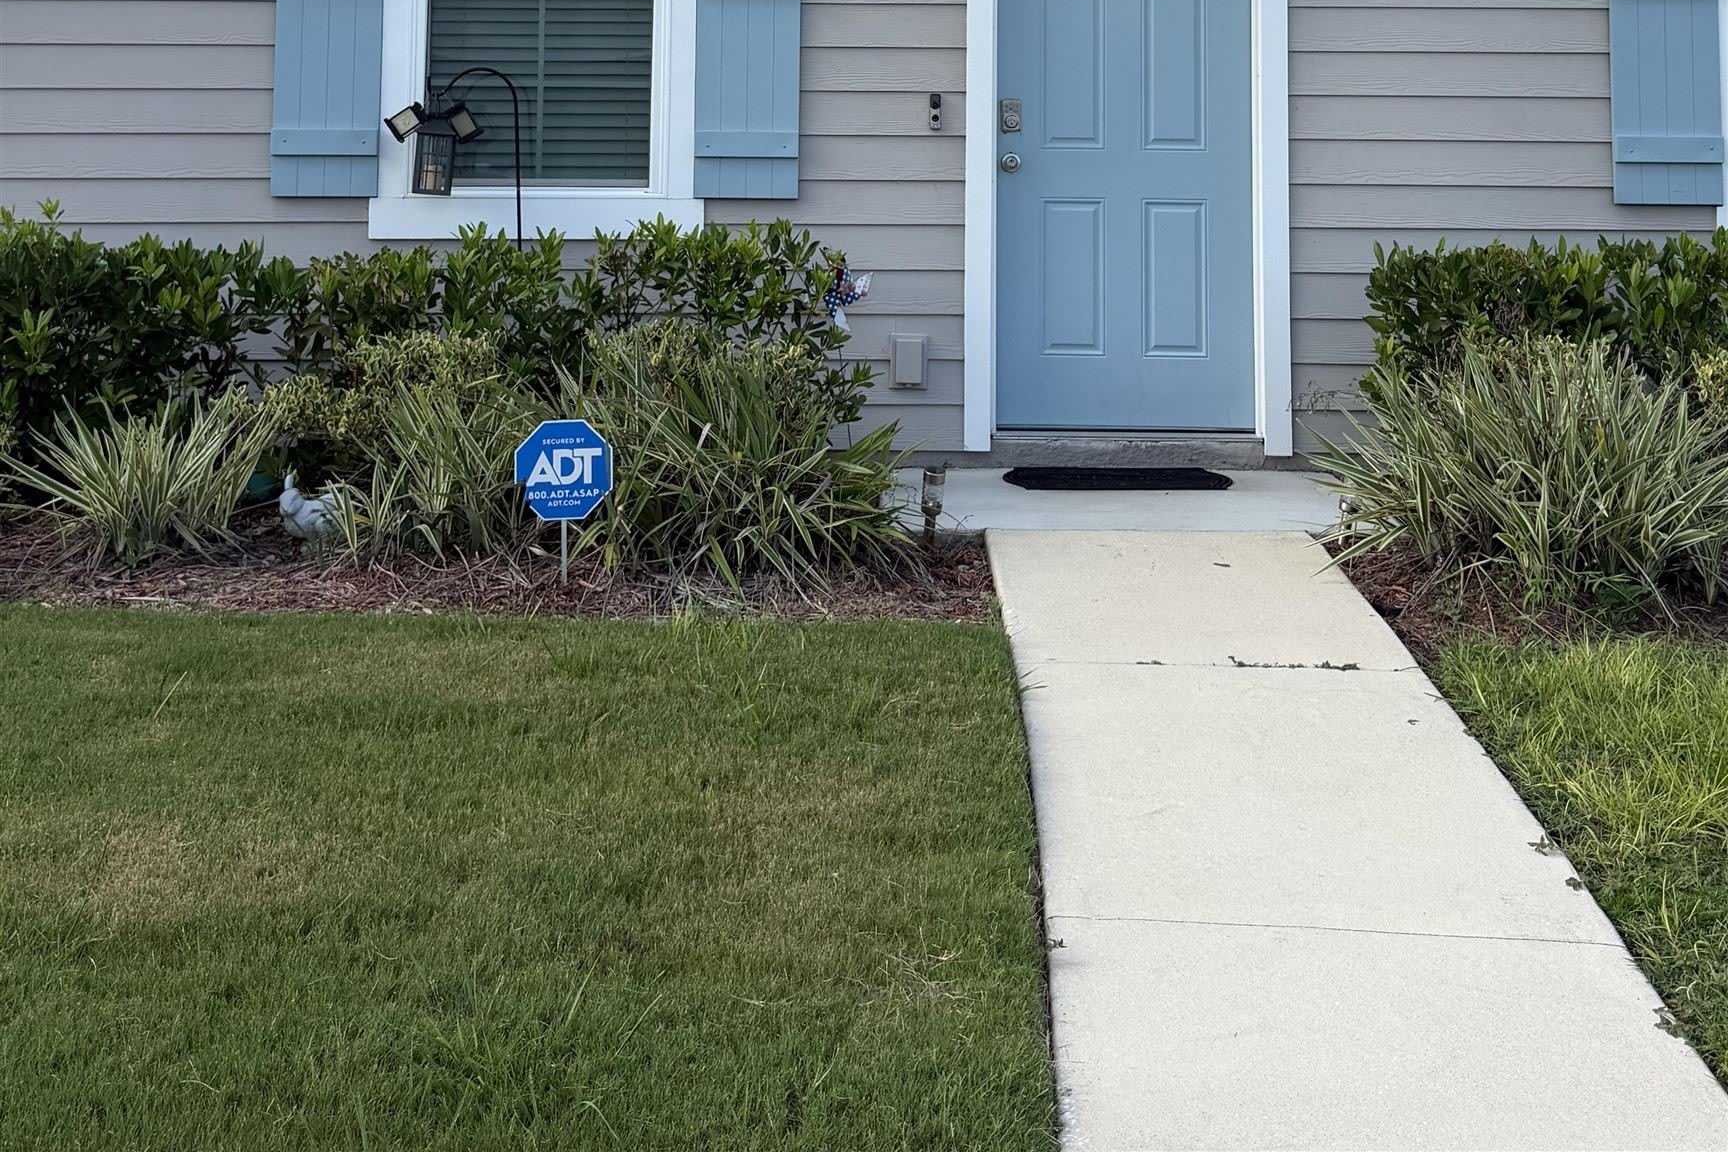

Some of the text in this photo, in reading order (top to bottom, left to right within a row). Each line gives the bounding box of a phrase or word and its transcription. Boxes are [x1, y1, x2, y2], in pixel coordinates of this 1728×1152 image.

[526, 448, 602, 486] ADT
[528, 488, 600, 500] 800.ADT.ASAP
[547, 499, 581, 507] ADT.COM
